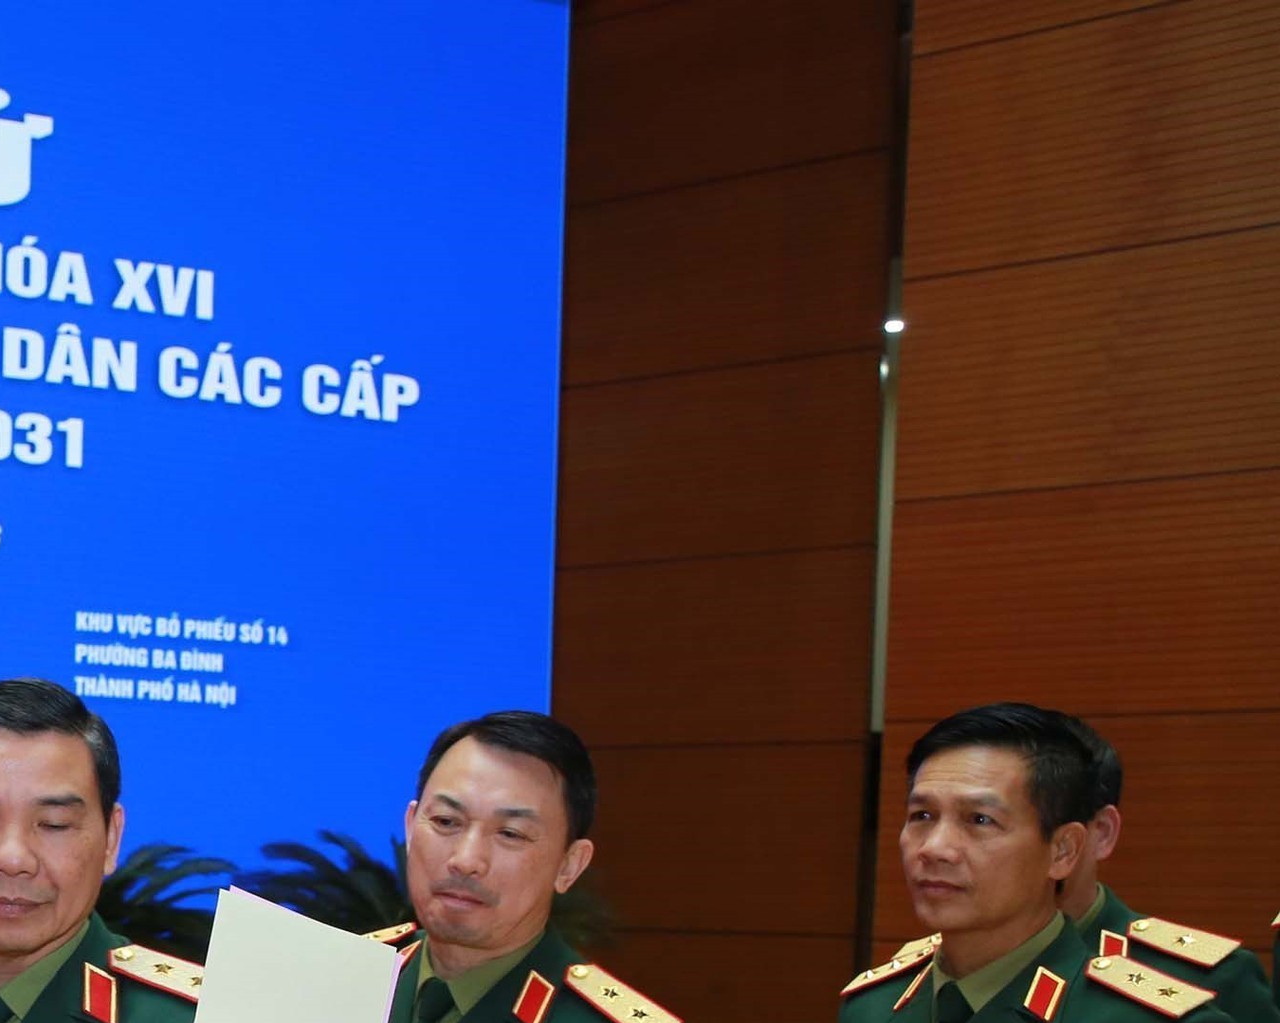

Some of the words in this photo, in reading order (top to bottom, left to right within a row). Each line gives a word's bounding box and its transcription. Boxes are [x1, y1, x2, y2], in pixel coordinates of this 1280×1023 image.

[113, 258, 215, 320] XVI
[2, 323, 138, 392] DÂN
[156, 342, 283, 408] CÁC
[302, 354, 420, 422] CẤP
[75, 611, 114, 633] KHU
[117, 614, 152, 639] VỰC
[155, 612, 181, 638] BỎ
[183, 616, 237, 642] PHIẾU
[239, 618, 264, 644] SỐ
[267, 626, 289, 646] 14
[152, 648, 177, 670] BA
[180, 648, 224, 672] ĐÌNH
[74, 673, 134, 699] THÀNH
[137, 675, 174, 702] PHỐ
[177, 679, 202, 703] HÀ
[205, 681, 237, 709] NỘI
